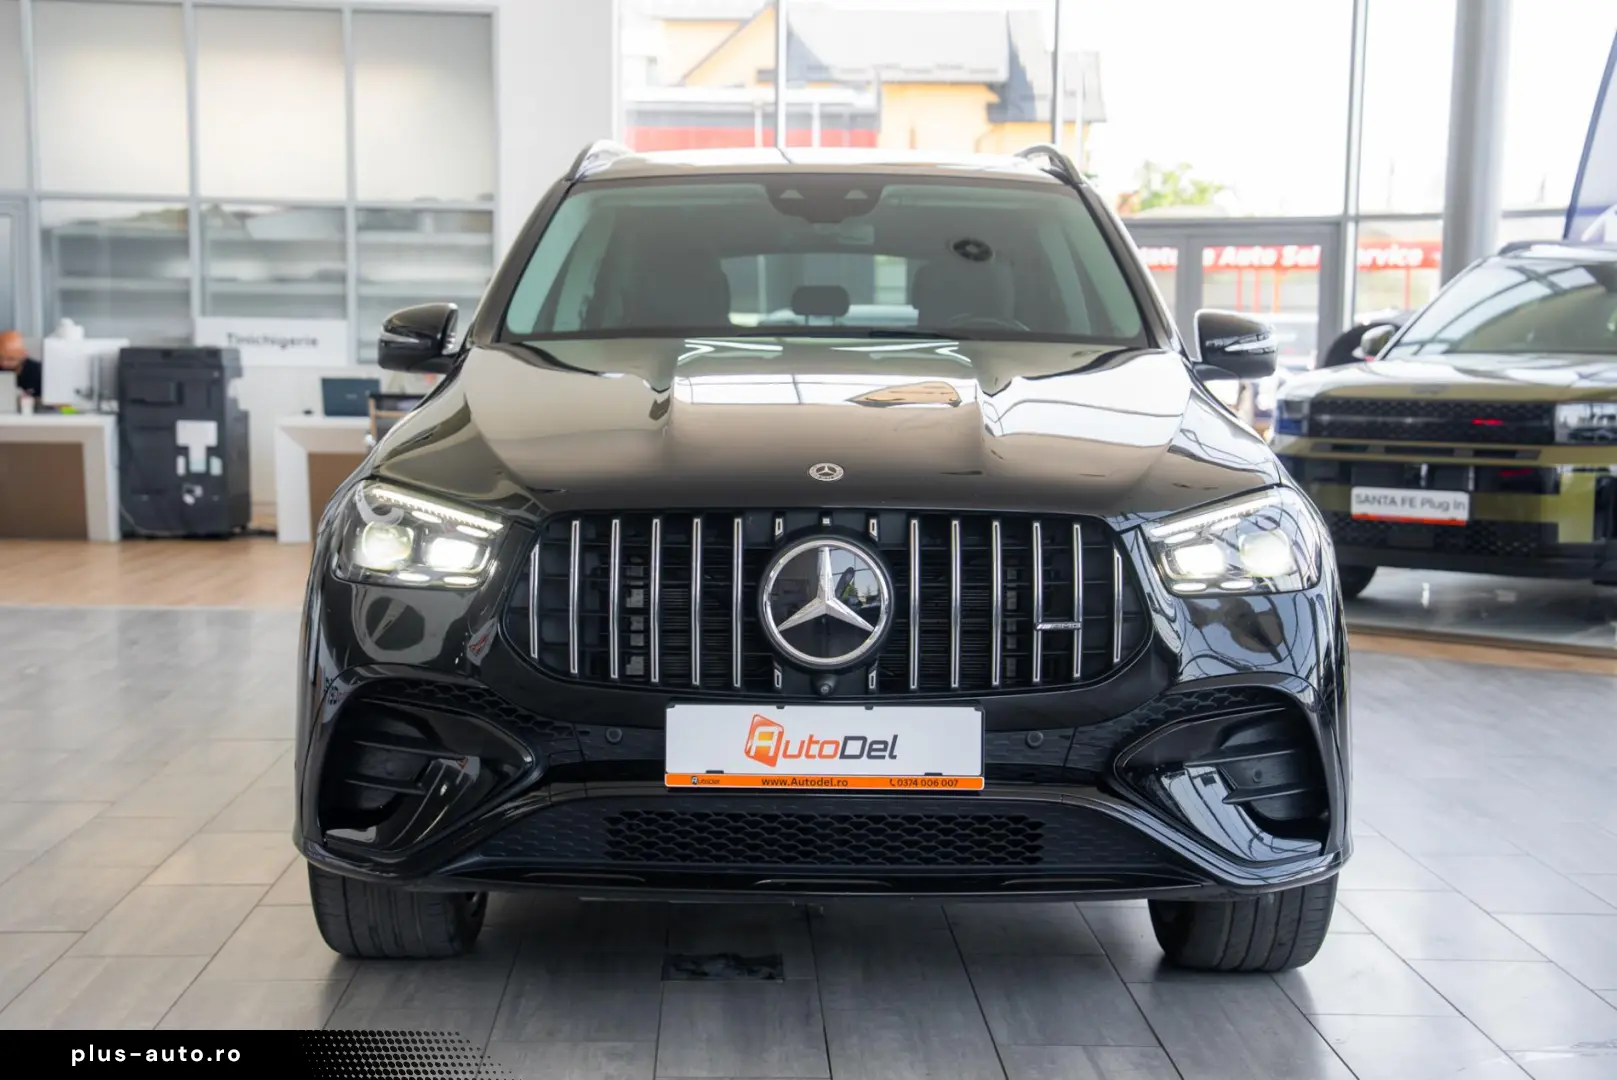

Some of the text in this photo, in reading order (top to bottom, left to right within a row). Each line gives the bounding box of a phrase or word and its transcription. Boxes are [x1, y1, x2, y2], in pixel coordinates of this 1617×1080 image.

[1219, 246, 1277, 266] Auto
[1280, 245, 1321, 266] Sal
[1355, 493, 1398, 507] SANTA
[1402, 496, 1417, 508] FE
[1420, 497, 1450, 512] Plug
[749, 724, 898, 760] AutoDel
[761, 777, 848, 787] www.Autodel.ro
[897, 778, 959, 787] 0374 006 007
